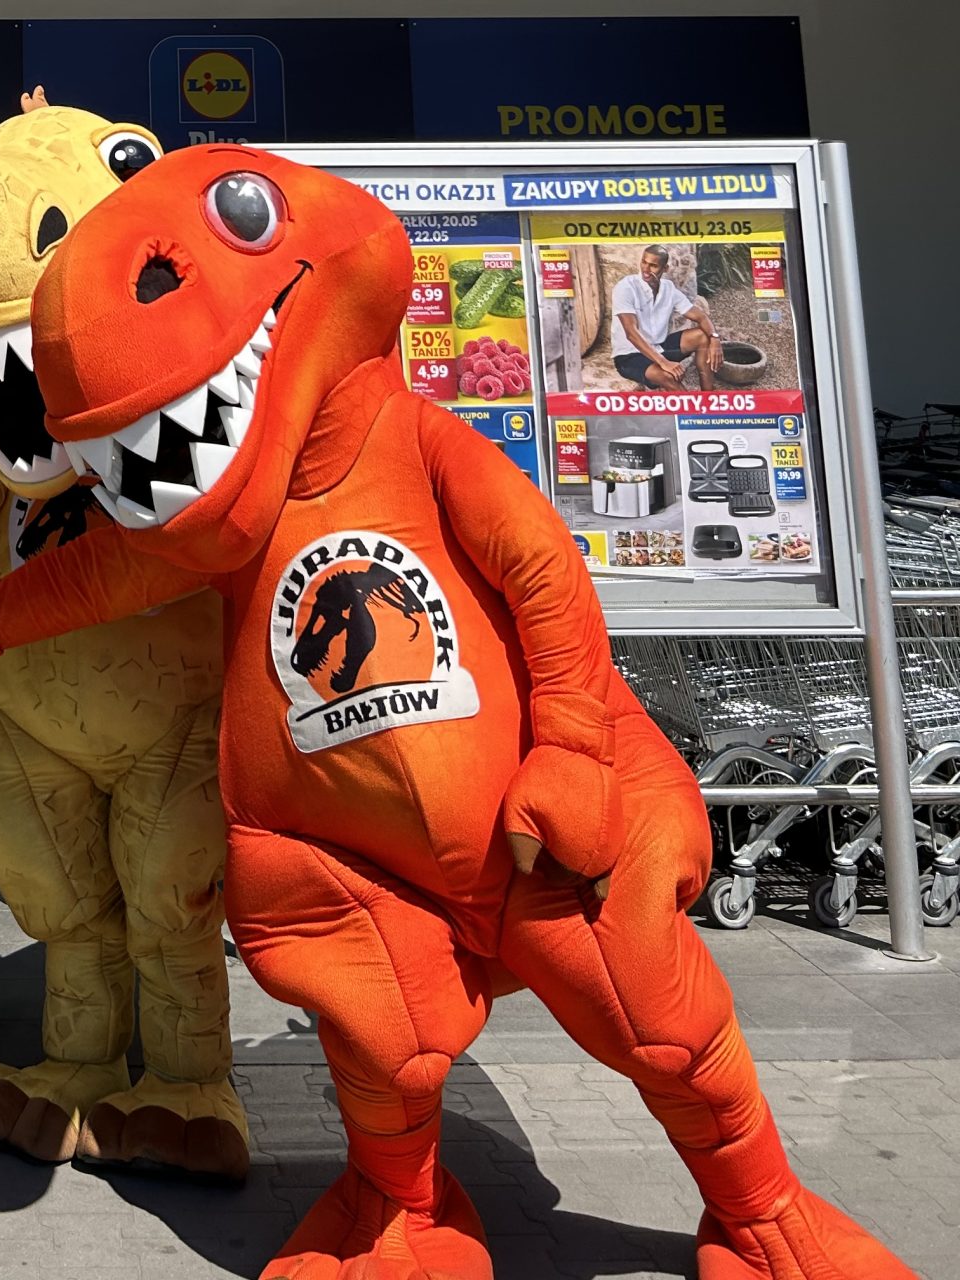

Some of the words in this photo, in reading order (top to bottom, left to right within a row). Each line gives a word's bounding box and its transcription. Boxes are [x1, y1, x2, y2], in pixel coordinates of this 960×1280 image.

[497, 104, 727, 135] PROMOCJE
[415, 184, 495, 200] OKAZJI
[511, 179, 599, 200] ZAKUPY
[602, 176, 673, 200] ROBIĘ
[676, 176, 697, 195] W
[702, 174, 767, 195] LIDLU
[401, 216, 441, 229] AŁKU,
[443, 215, 478, 227] 20.05
[564, 222, 591, 238] OD
[596, 220, 704, 238] CZWARTKU,
[707, 220, 752, 235] 23.05
[415, 231, 449, 242] 22.05
[543, 262, 569, 272] 39,99
[754, 260, 780, 270] 34,99
[413, 272, 444, 280] ANIEJ
[411, 288, 443, 303] 6,99
[411, 331, 451, 347] 50%
[412, 348, 450, 357] TANIEJ
[417, 365, 449, 379] 4,99
[595, 395, 625, 412] OD
[628, 394, 706, 413] SOBOTY,
[708, 394, 756, 411] 25.05
[460, 412, 490, 420] KUPON
[557, 424, 573, 432] 100
[775, 449, 787, 459] 10
[777, 471, 801, 480] 39,99
[278, 537, 456, 673] JURAPARK
[323, 688, 439, 734] BAŁTÓW
